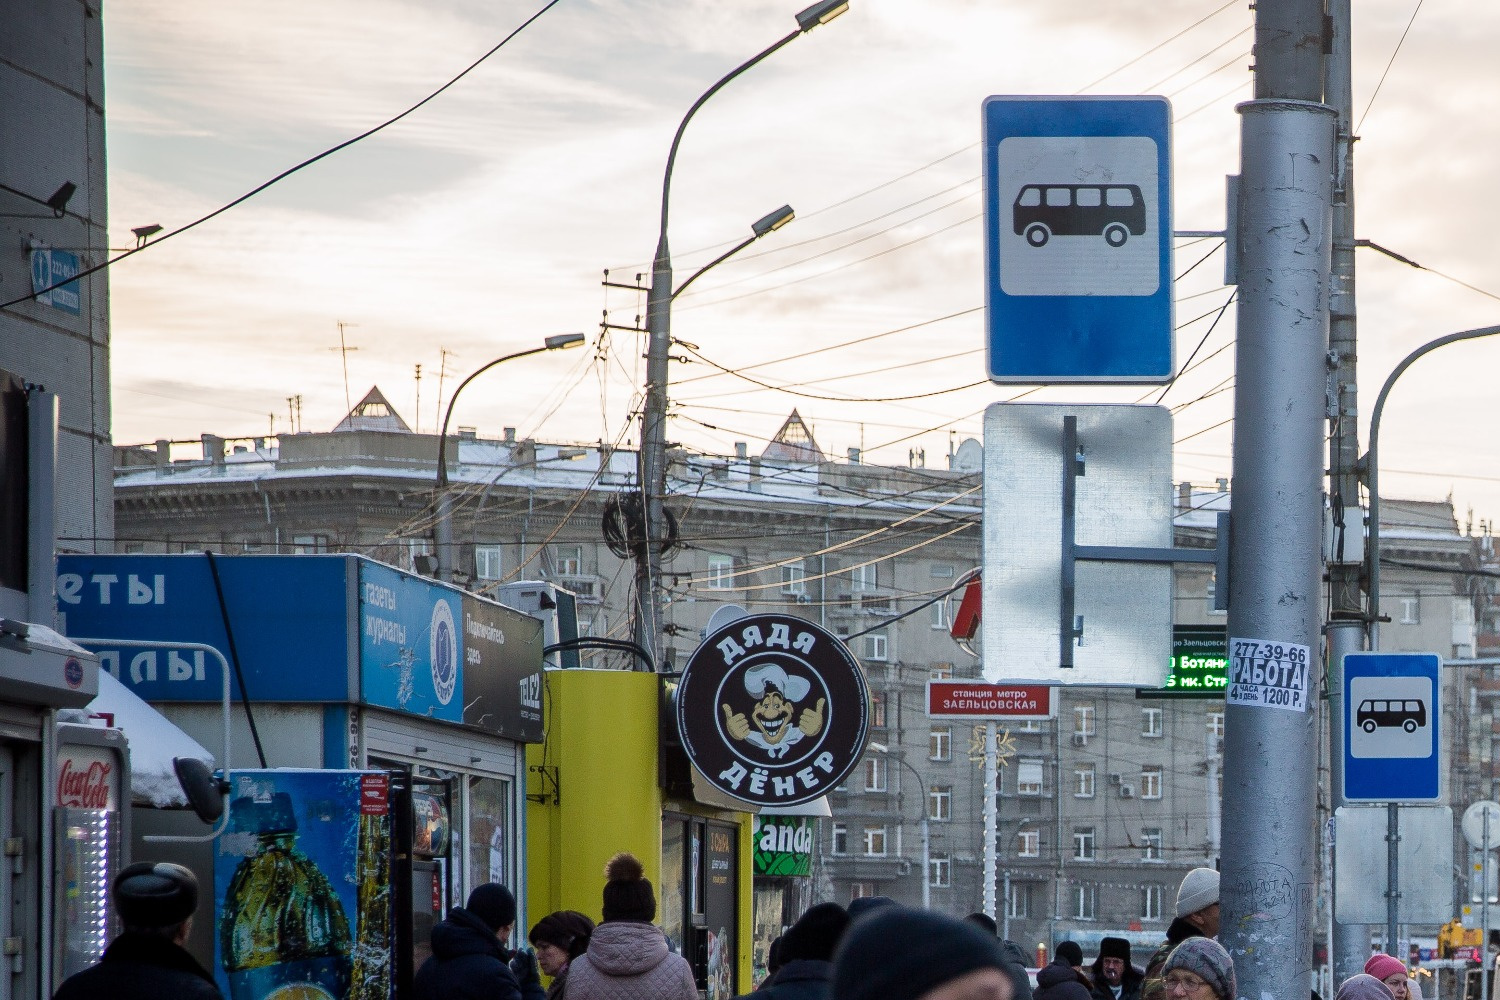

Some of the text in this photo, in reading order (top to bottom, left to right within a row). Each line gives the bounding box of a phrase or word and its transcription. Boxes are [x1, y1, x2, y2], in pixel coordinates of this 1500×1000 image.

[365, 582, 396, 611] газеты
[366, 615, 407, 645] журналы
[716, 622, 816, 666] ДЯДЯ
[1234, 642, 1306, 663] 277-39-66
[1232, 657, 1304, 690] РАБОТА
[519, 673, 540, 709] TELE2
[952, 690, 1027, 699] станция метро
[1231, 685, 1239, 700] 4
[1240, 685, 1259, 693] ЧАСА
[1243, 693, 1259, 702] ДЕНЬ
[1262, 687, 1302, 708] 1200 Р.
[943, 700, 1037, 710] ЗАЕЛЬЦОВСКАЯ
[719, 751, 834, 797] ДЁНЕР
